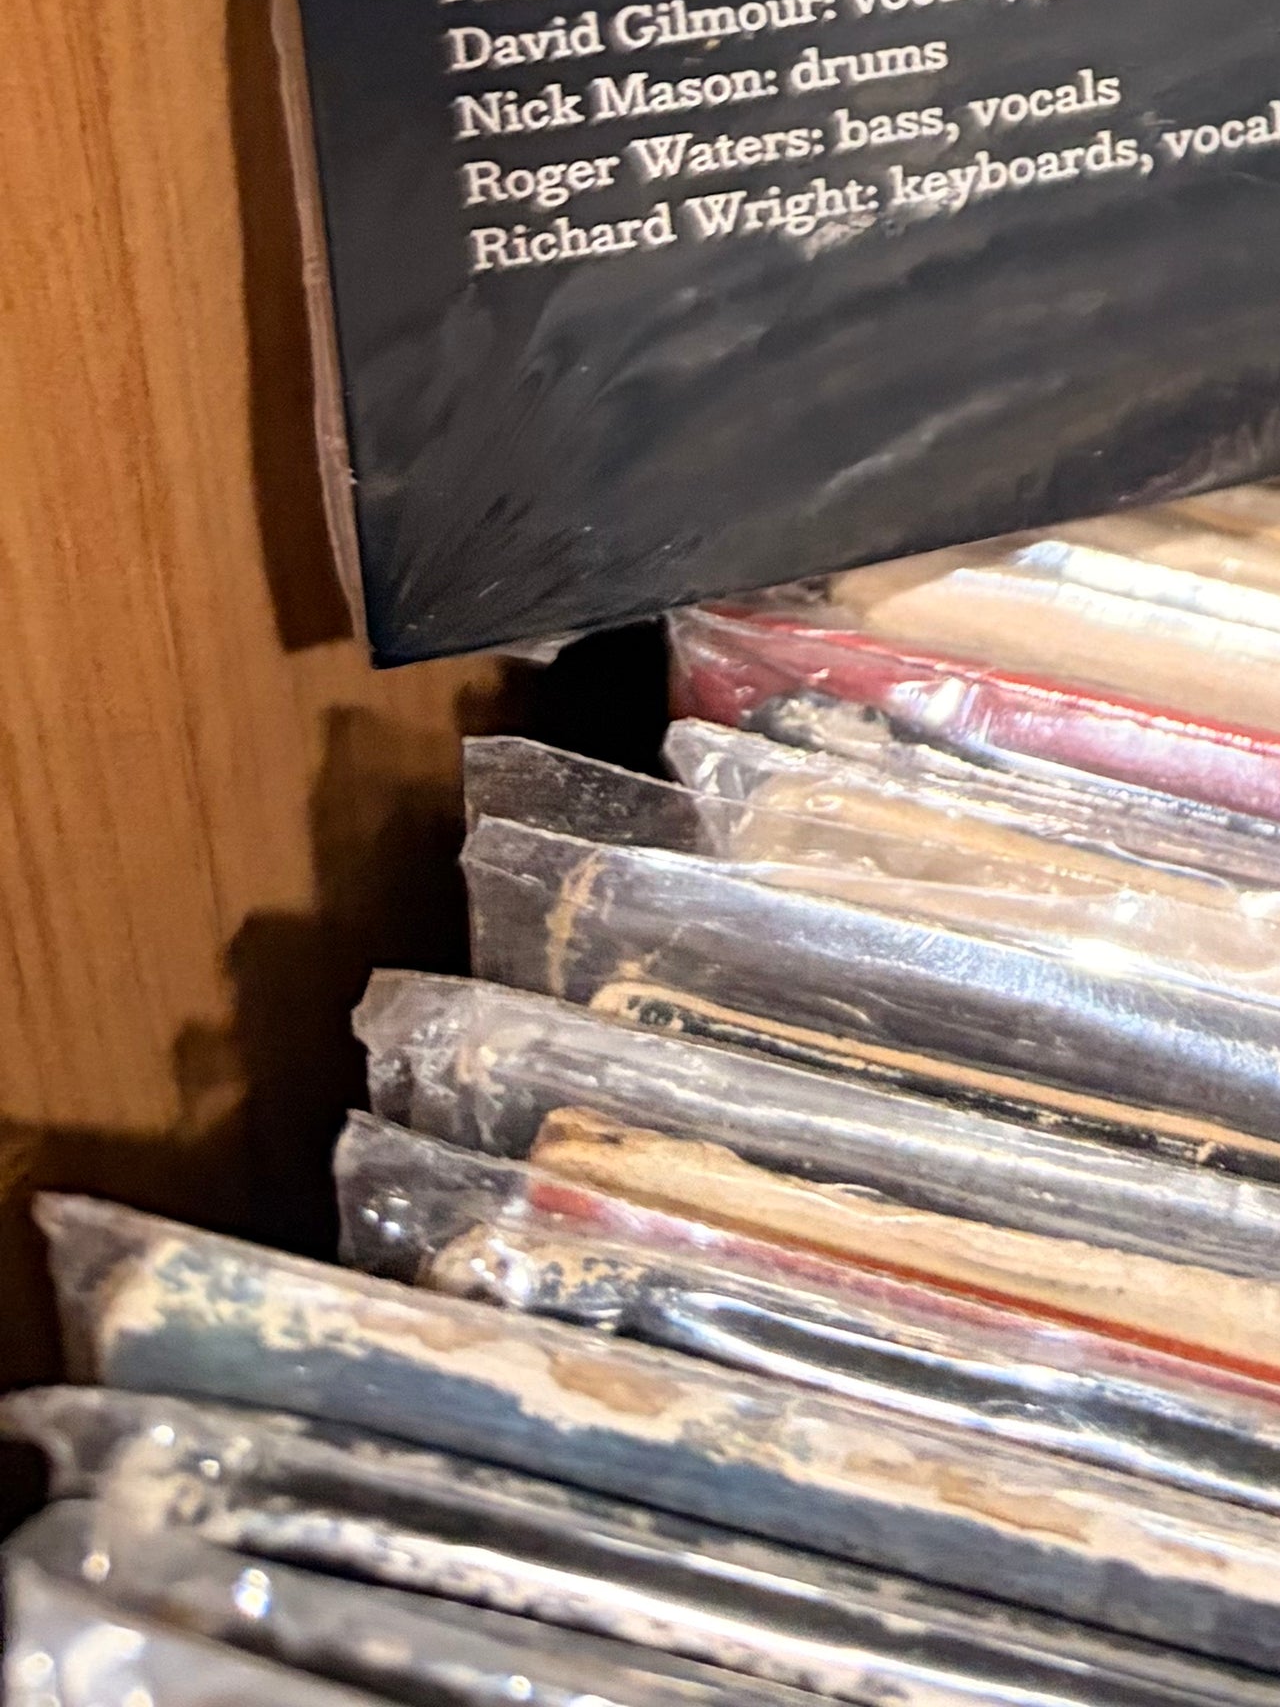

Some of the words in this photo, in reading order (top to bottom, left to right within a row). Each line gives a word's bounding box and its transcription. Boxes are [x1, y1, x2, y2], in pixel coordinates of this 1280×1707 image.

[449, 11, 605, 69] David
[456, 84, 585, 137] Nick
[593, 70, 778, 120] Mason:
[790, 42, 947, 91] drums
[464, 157, 620, 208] Roger
[629, 129, 824, 179] Waters:
[834, 108, 959, 151] bass,
[968, 69, 1120, 127] vocals
[471, 203, 677, 270] Richard
[685, 178, 878, 239] Wright:
[888, 131, 1153, 205] keyboards,
